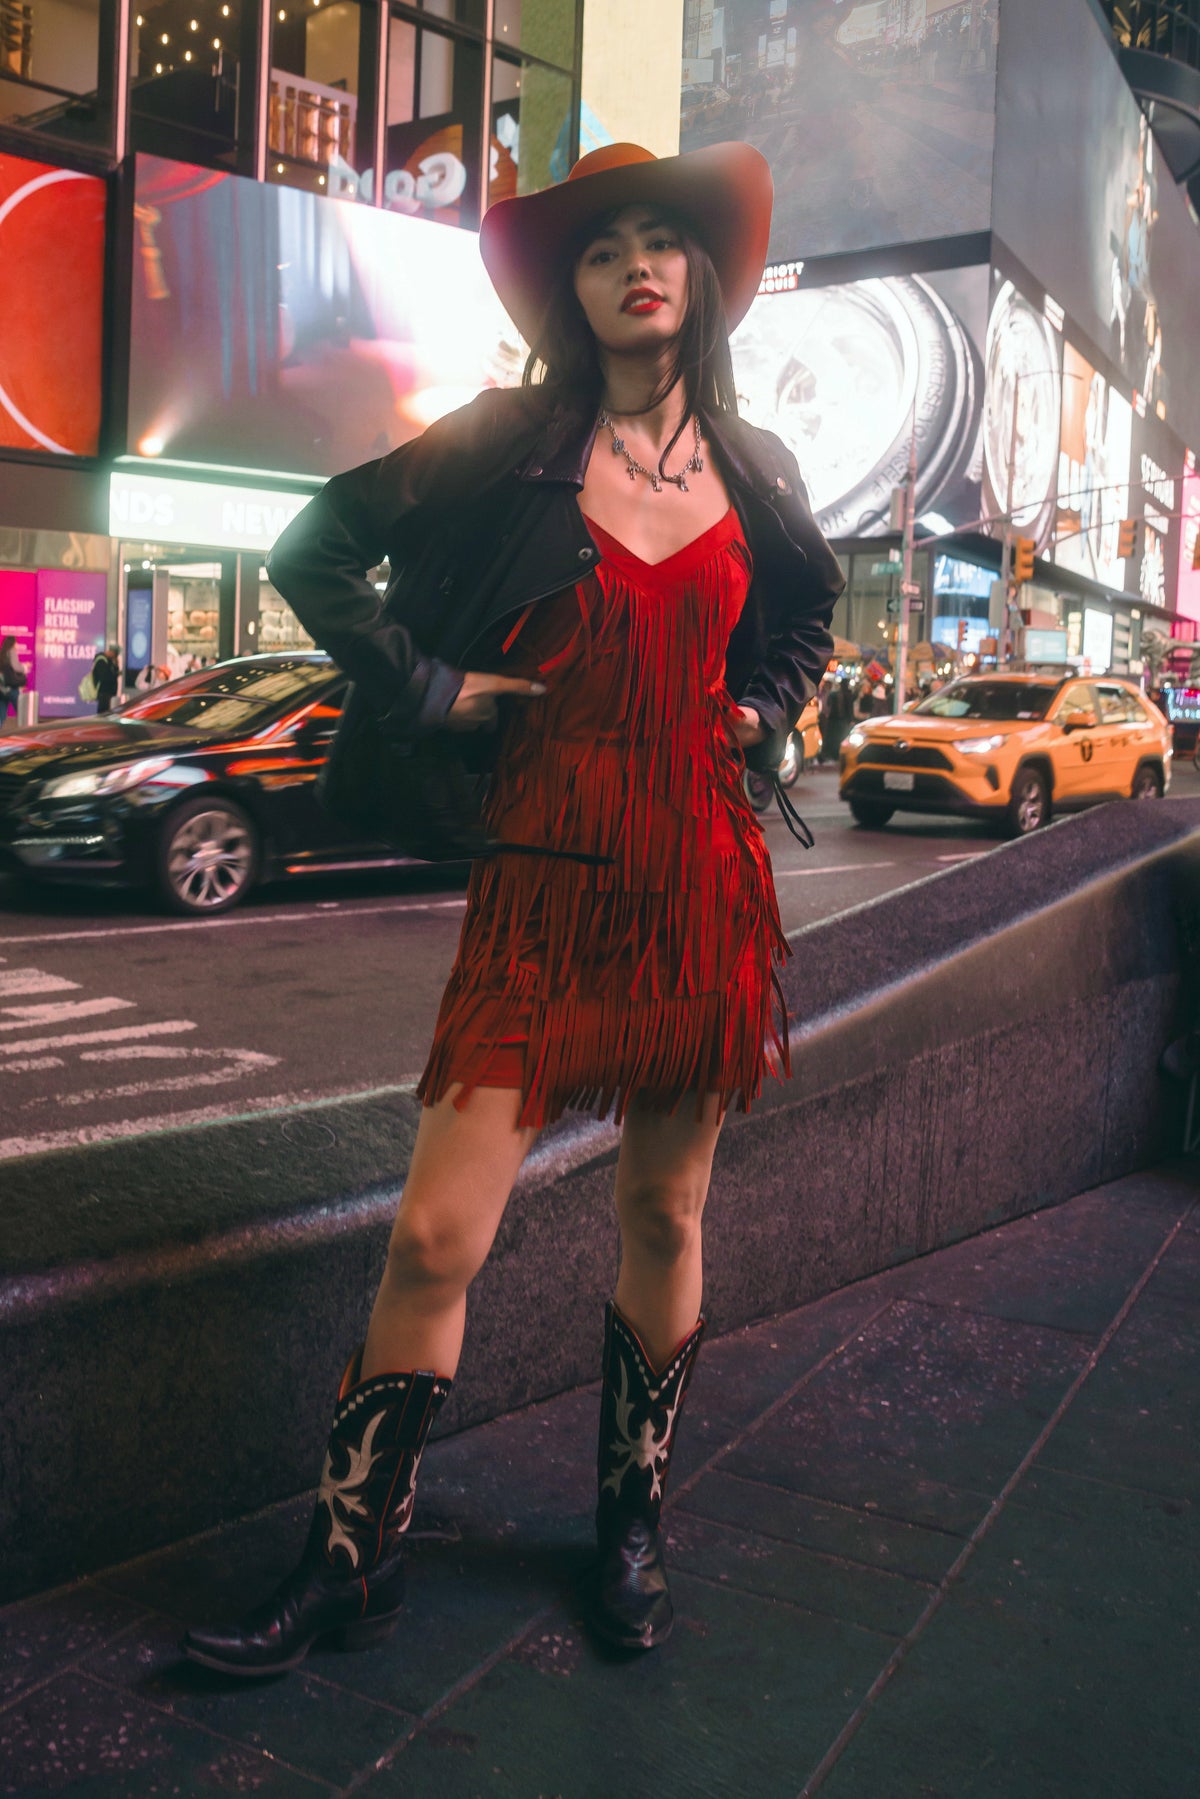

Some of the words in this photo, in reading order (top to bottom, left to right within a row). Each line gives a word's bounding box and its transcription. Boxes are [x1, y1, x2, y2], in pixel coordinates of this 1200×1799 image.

[762, 262, 804, 281] RIOTT
[44, 597, 95, 614] FLAGSHIP
[44, 613, 79, 629] RETAIL
[44, 628, 77, 644] SPACE
[44, 643, 65, 659] FOR
